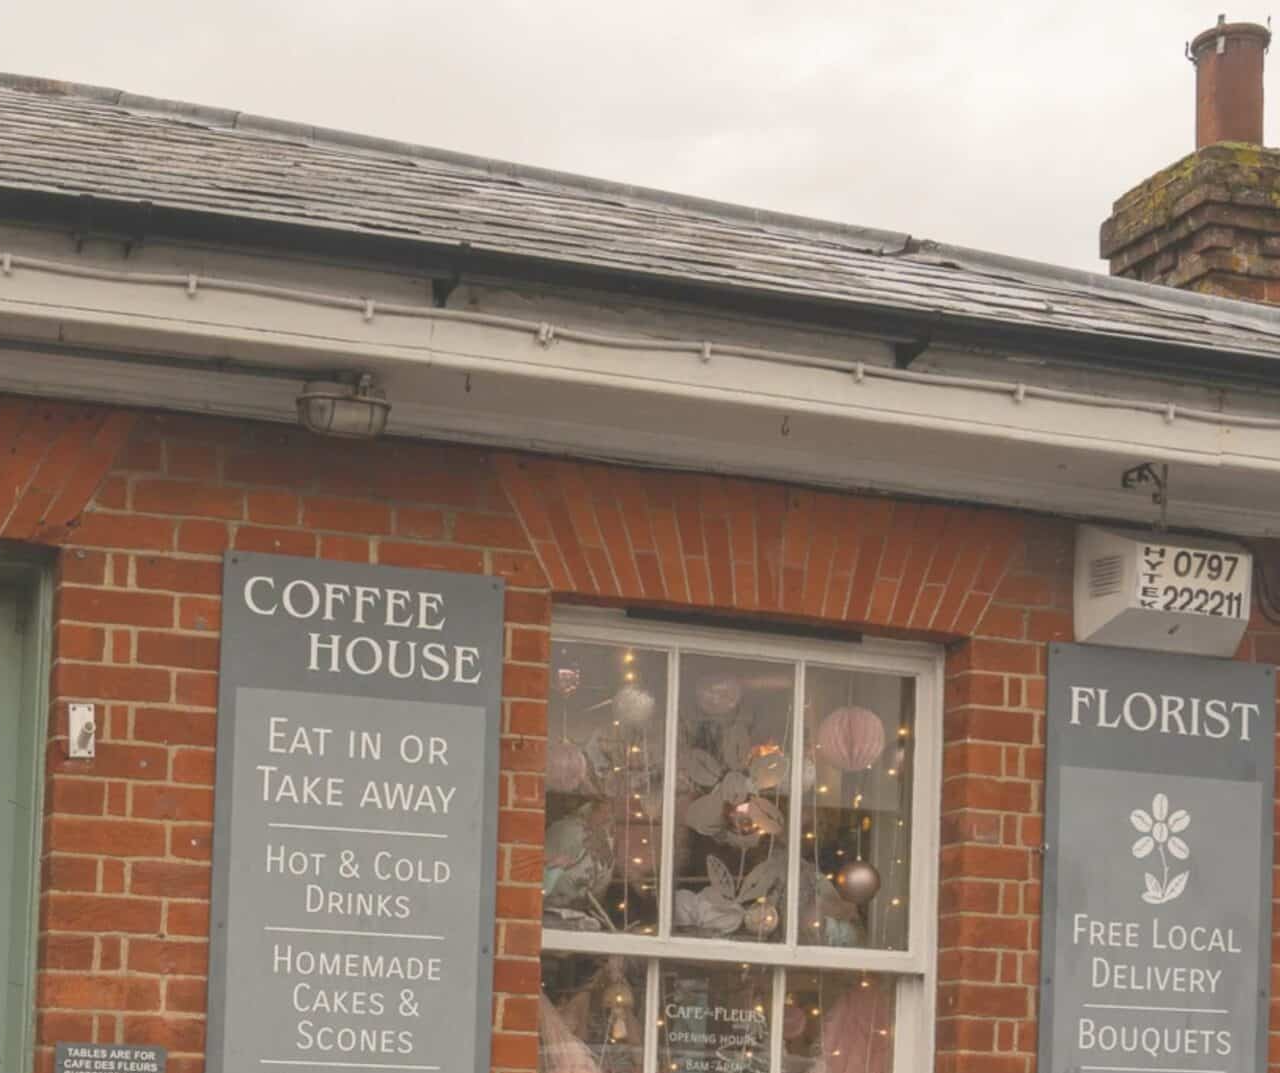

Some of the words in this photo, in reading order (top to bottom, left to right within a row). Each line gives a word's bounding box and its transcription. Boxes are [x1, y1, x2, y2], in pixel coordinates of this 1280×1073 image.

[1174, 550, 1239, 582] 0797
[244, 576, 446, 631] COFFEE
[1163, 585, 1242, 618] 222211
[306, 632, 482, 684] HOUSE
[1069, 685, 1260, 742] FLORIST
[269, 717, 333, 757] EAT
[349, 730, 382, 761] IN
[400, 735, 448, 766] OR
[256, 765, 344, 808] TAKE
[359, 780, 457, 815] AWAY
[266, 844, 326, 877] HOT
[339, 849, 360, 880] &
[374, 851, 450, 884] COLD
[306, 884, 410, 919] DRINKS
[1073, 913, 1140, 948] FREE
[1152, 917, 1241, 953] LOCAL
[273, 944, 441, 981] HOMEMADE
[1091, 957, 1222, 994] DELIVERY
[293, 983, 385, 1016] CAKES
[399, 988, 420, 1017] &
[714, 1006, 767, 1023] FLEURS
[67, 1047, 107, 1058] TABLES
[110, 1049, 131, 1059] ARE
[134, 1051, 155, 1060] FOR
[296, 1020, 414, 1054] SCONES
[1078, 1018, 1232, 1058] BOUQUETS
[63, 1059, 92, 1069] CAFE
[94, 1060, 115, 1070] DES
[117, 1061, 158, 1072] FLEURS
